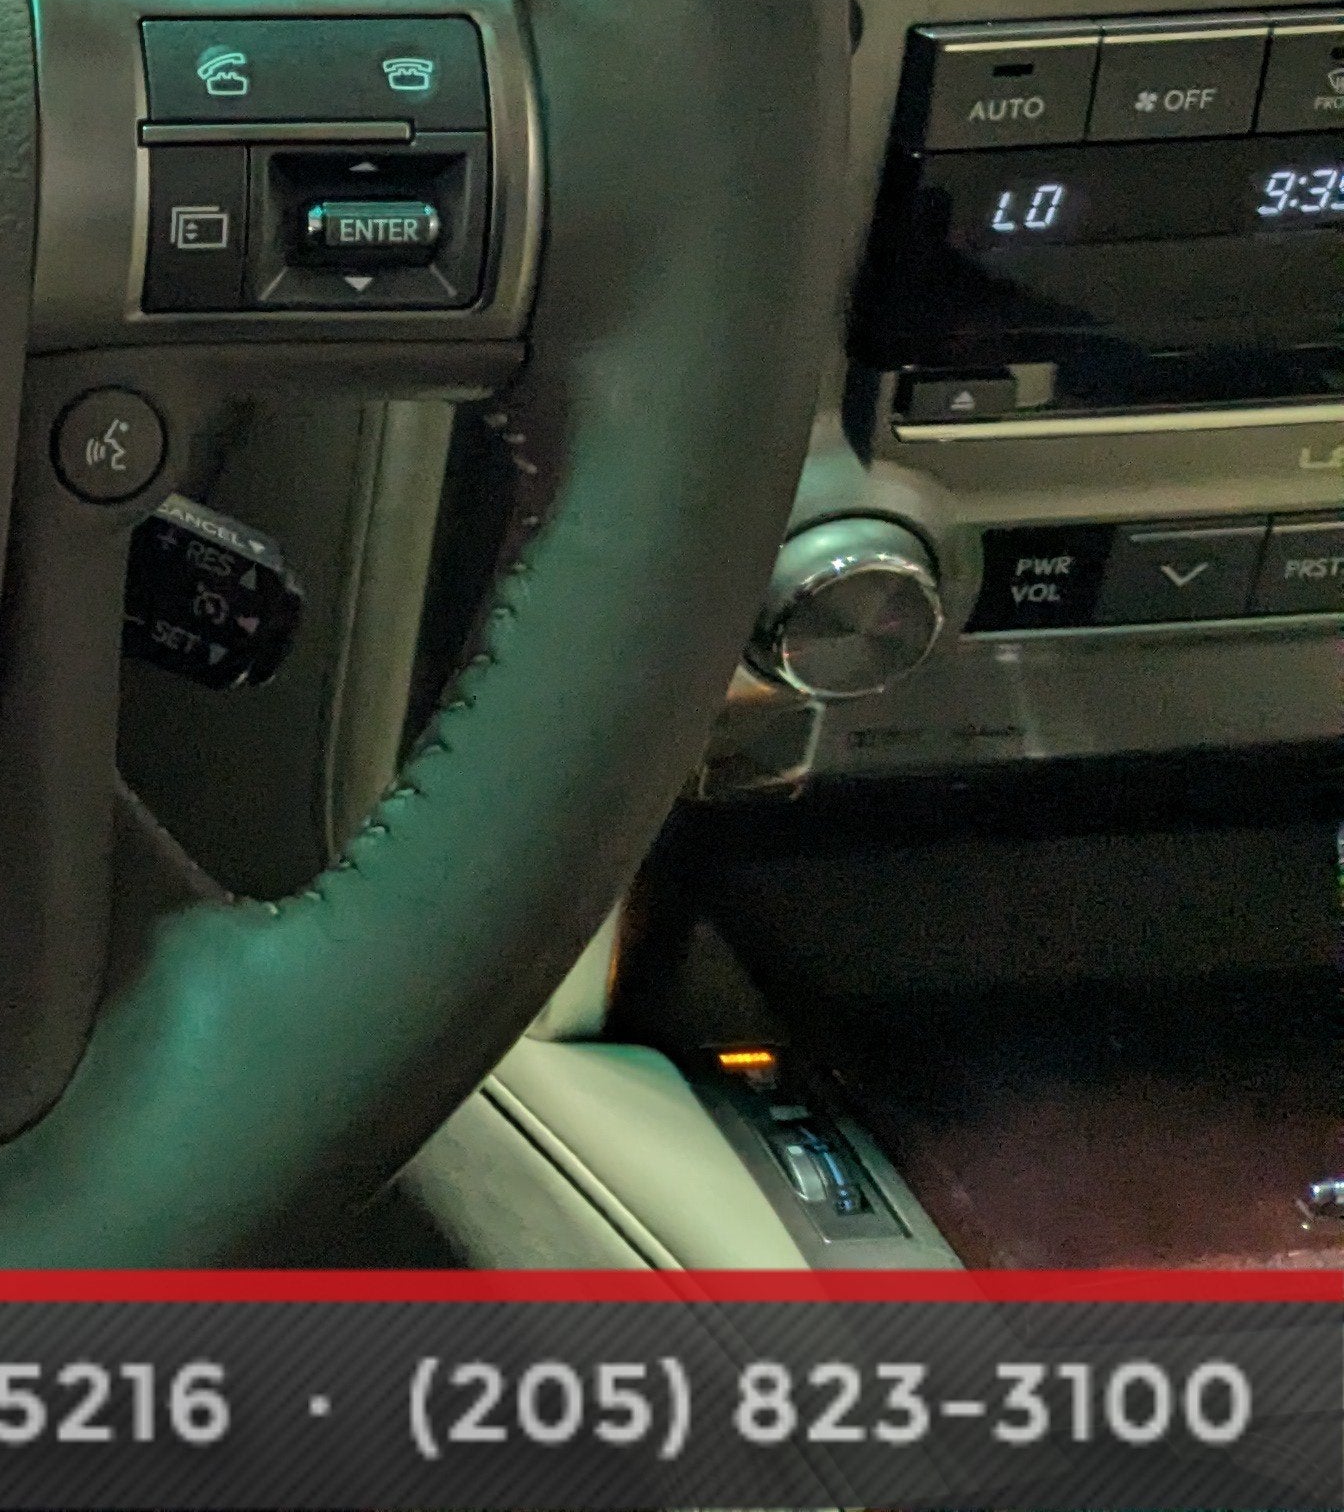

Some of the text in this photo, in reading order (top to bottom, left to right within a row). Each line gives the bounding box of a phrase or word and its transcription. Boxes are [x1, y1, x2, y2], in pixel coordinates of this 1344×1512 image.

[969, 98, 1044, 122] AUTO
[1164, 88, 1218, 112] OFF
[1256, 168, 1344, 216] 9:3
[340, 218, 418, 243] ENTER
[158, 504, 248, 550] CANCEL
[188, 541, 236, 577] RES
[1015, 557, 1071, 576] PWR
[1011, 585, 1061, 603] VOL
